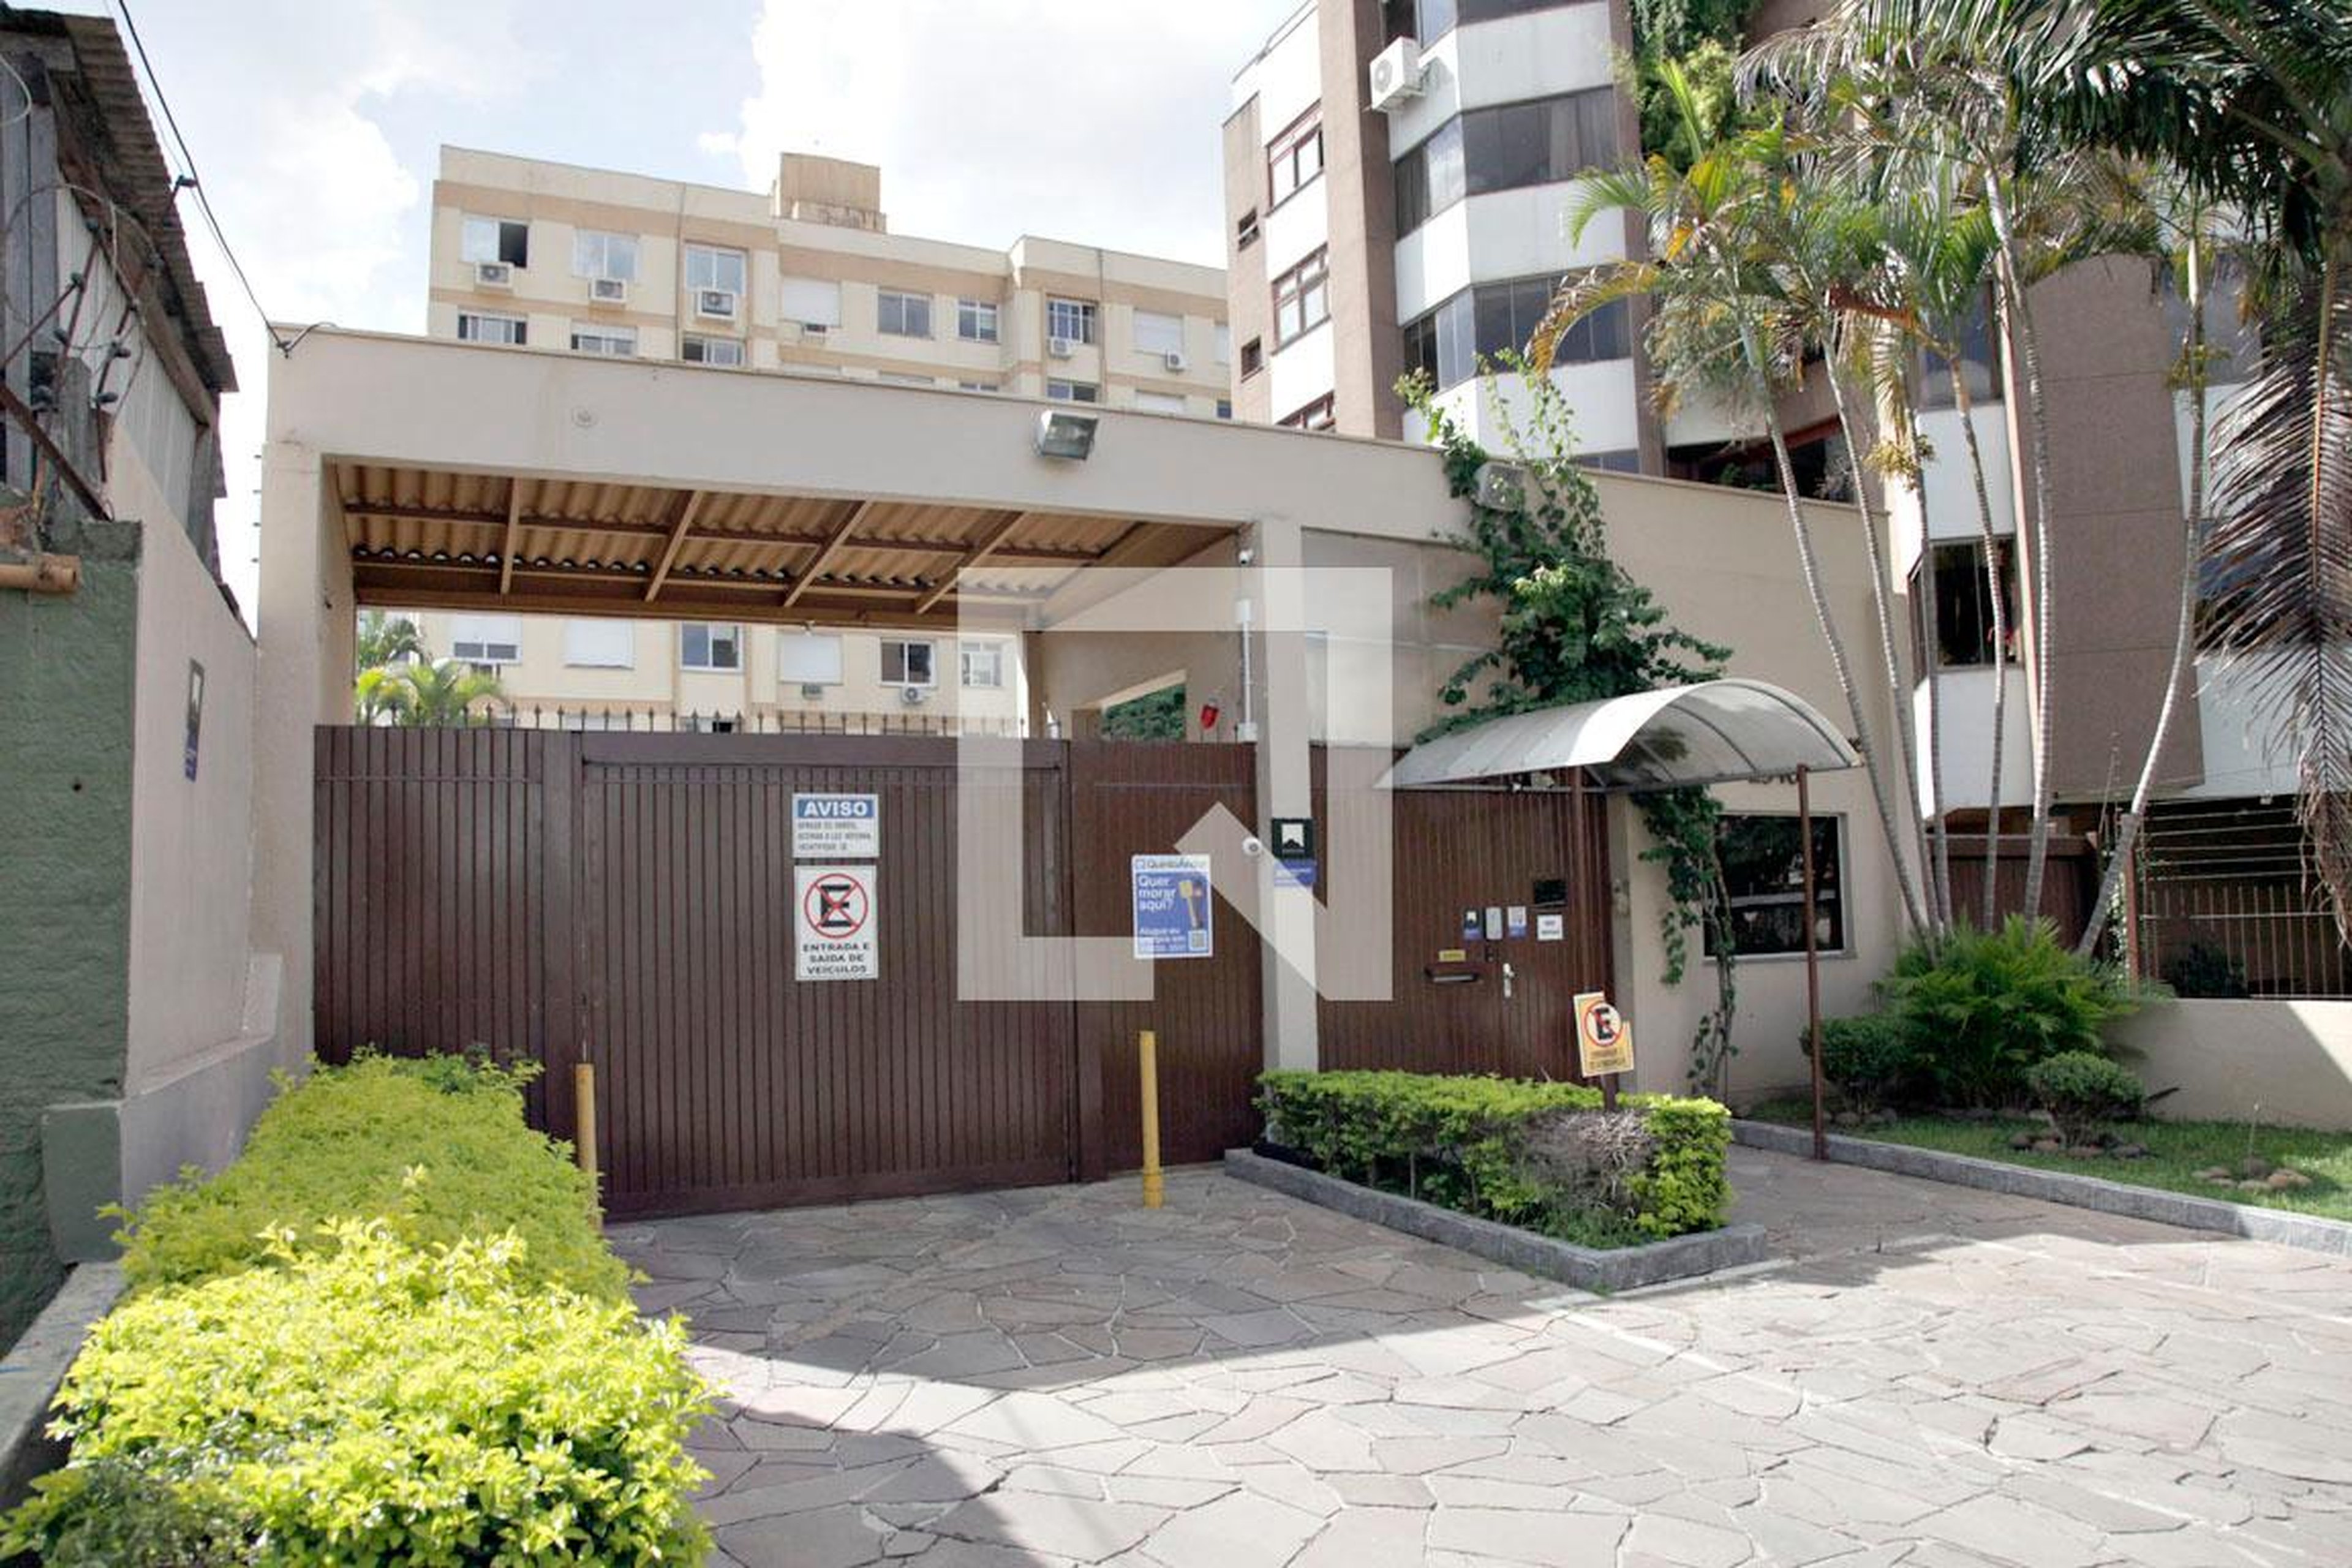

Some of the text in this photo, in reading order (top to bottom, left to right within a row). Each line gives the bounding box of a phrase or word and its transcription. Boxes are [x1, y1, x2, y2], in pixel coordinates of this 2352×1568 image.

[804, 801, 869, 817] AVISO
[1139, 875, 1170, 887] Quer
[1139, 889, 1176, 899] morar
[803, 943, 859, 951] ENTRADA
[849, 954, 865, 962] DE
